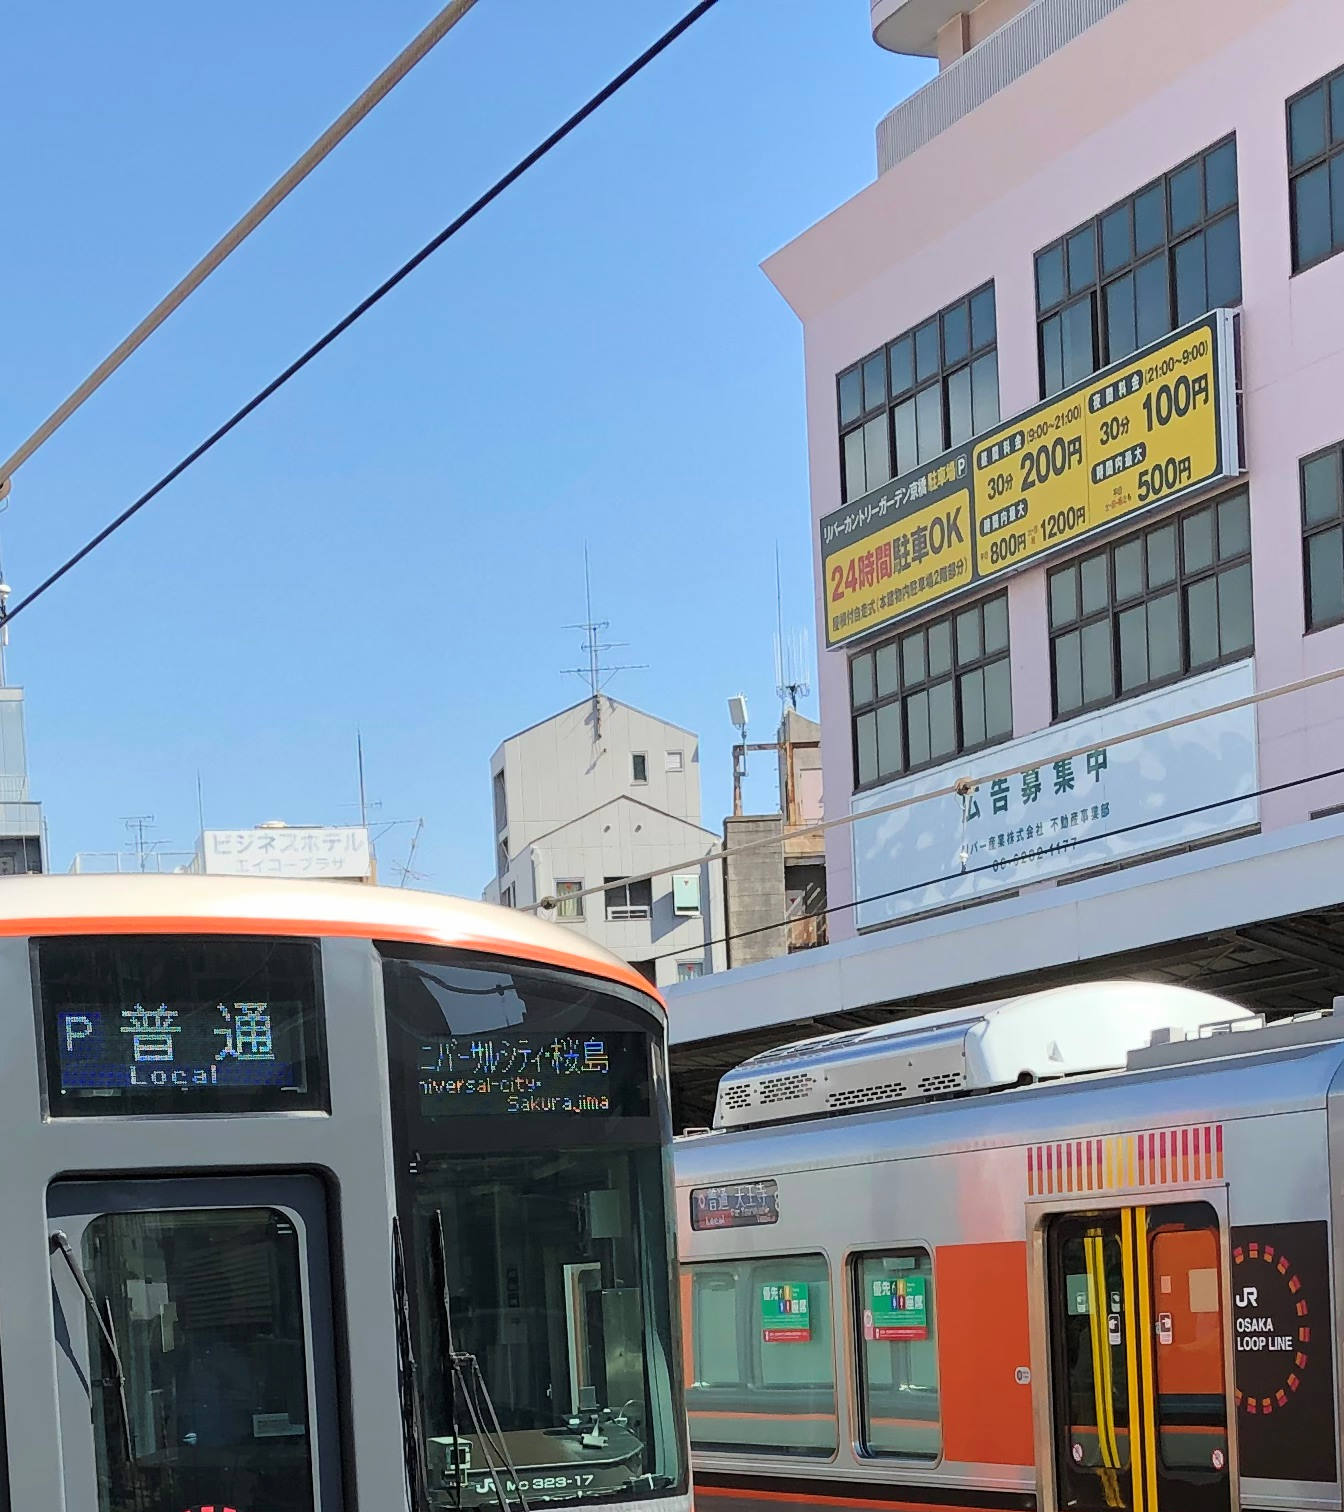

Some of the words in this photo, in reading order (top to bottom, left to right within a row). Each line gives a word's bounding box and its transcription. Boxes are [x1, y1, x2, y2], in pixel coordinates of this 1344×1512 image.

[1099, 415, 1130, 446] 30分
[1142, 372, 1209, 433] 100円
[987, 473, 1014, 500] 30分
[1020, 435, 1083, 493] 200円
[1137, 455, 1191, 502] 500円
[990, 532, 1027, 564] 800円
[1040, 506, 1086, 542] 1200円
[120, 1002, 276, 1062] 普通
[129, 1063, 218, 1085] Local
[507, 1095, 610, 1113] Sakurajima
[1235, 1286, 1259, 1308] JR
[1236, 1317, 1275, 1333] OSAKA
[1237, 1336, 1267, 1351] LOOP
[1268, 1336, 1294, 1351] LINE
[532, 1474, 595, 1490] 323-17
